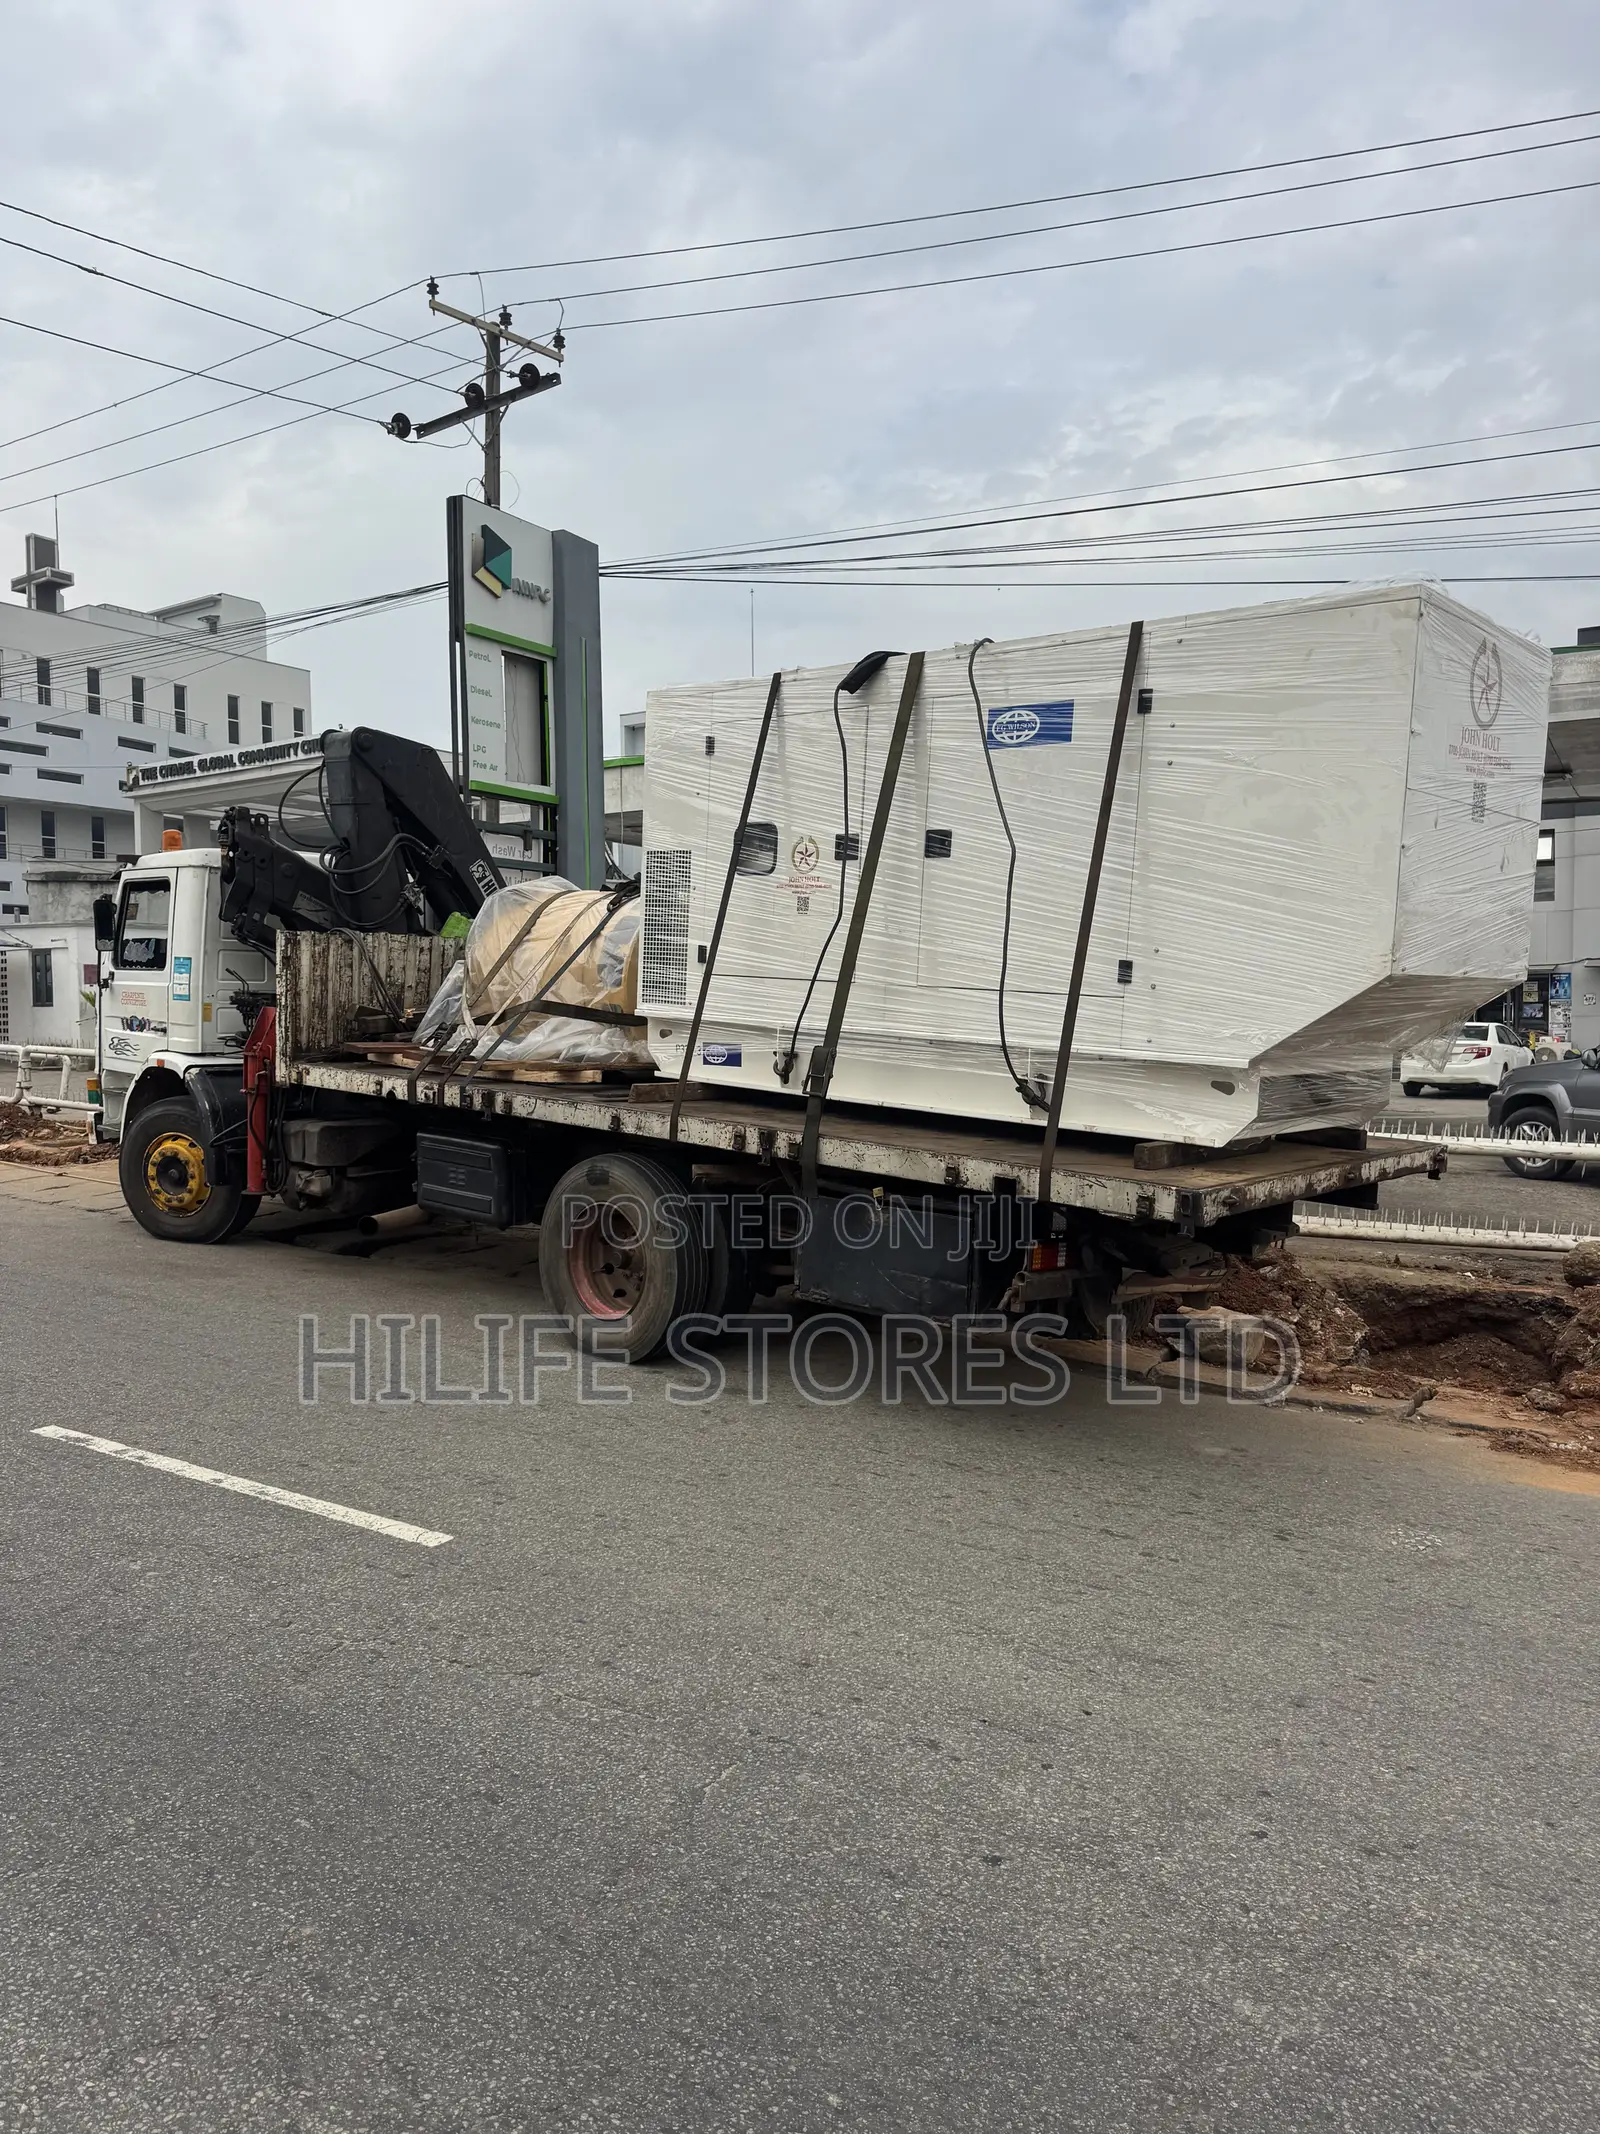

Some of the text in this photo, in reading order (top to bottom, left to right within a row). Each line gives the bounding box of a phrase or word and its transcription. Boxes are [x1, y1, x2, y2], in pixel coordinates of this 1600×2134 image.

[468, 650, 491, 662] Petrol
[470, 685, 492, 698] Diesel
[470, 716, 501, 729] Kerosene
[1008, 721, 1036, 730] WILSON
[1461, 727, 1501, 752] JOHN HOLT
[472, 744, 487, 754] LPG
[140, 767, 158, 782] THE
[159, 760, 196, 779] CITADEL
[198, 754, 236, 772] GLOBAL
[238, 741, 300, 765] COMMUNITY
[472, 760, 498, 772] Free Air
